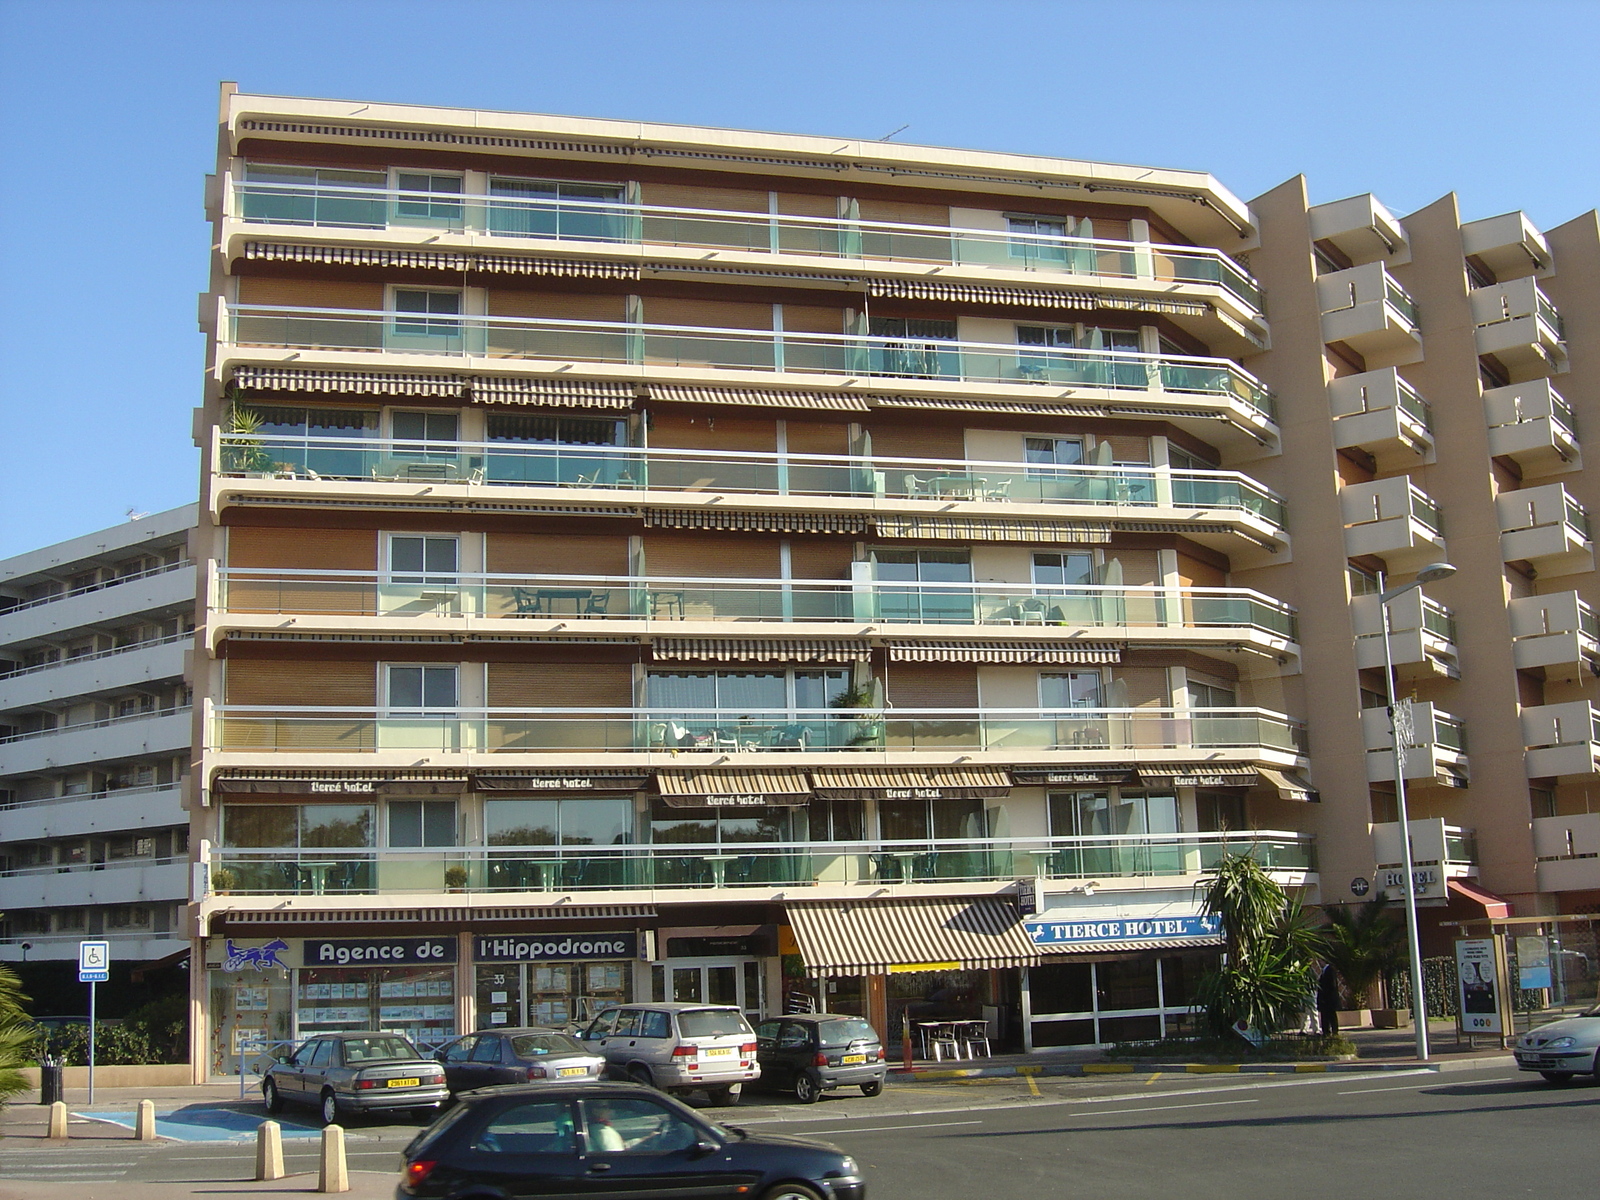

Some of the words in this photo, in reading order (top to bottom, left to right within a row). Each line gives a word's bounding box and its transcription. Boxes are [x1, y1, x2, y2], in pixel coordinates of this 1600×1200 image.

[1051, 923, 1121, 939] TIERCE
[1124, 920, 1187, 936] HOTEL
[319, 943, 404, 964] Agence
[416, 941, 444, 958] de
[481, 938, 625, 960] l'Hippodrome
[493, 974, 505, 985] 33
